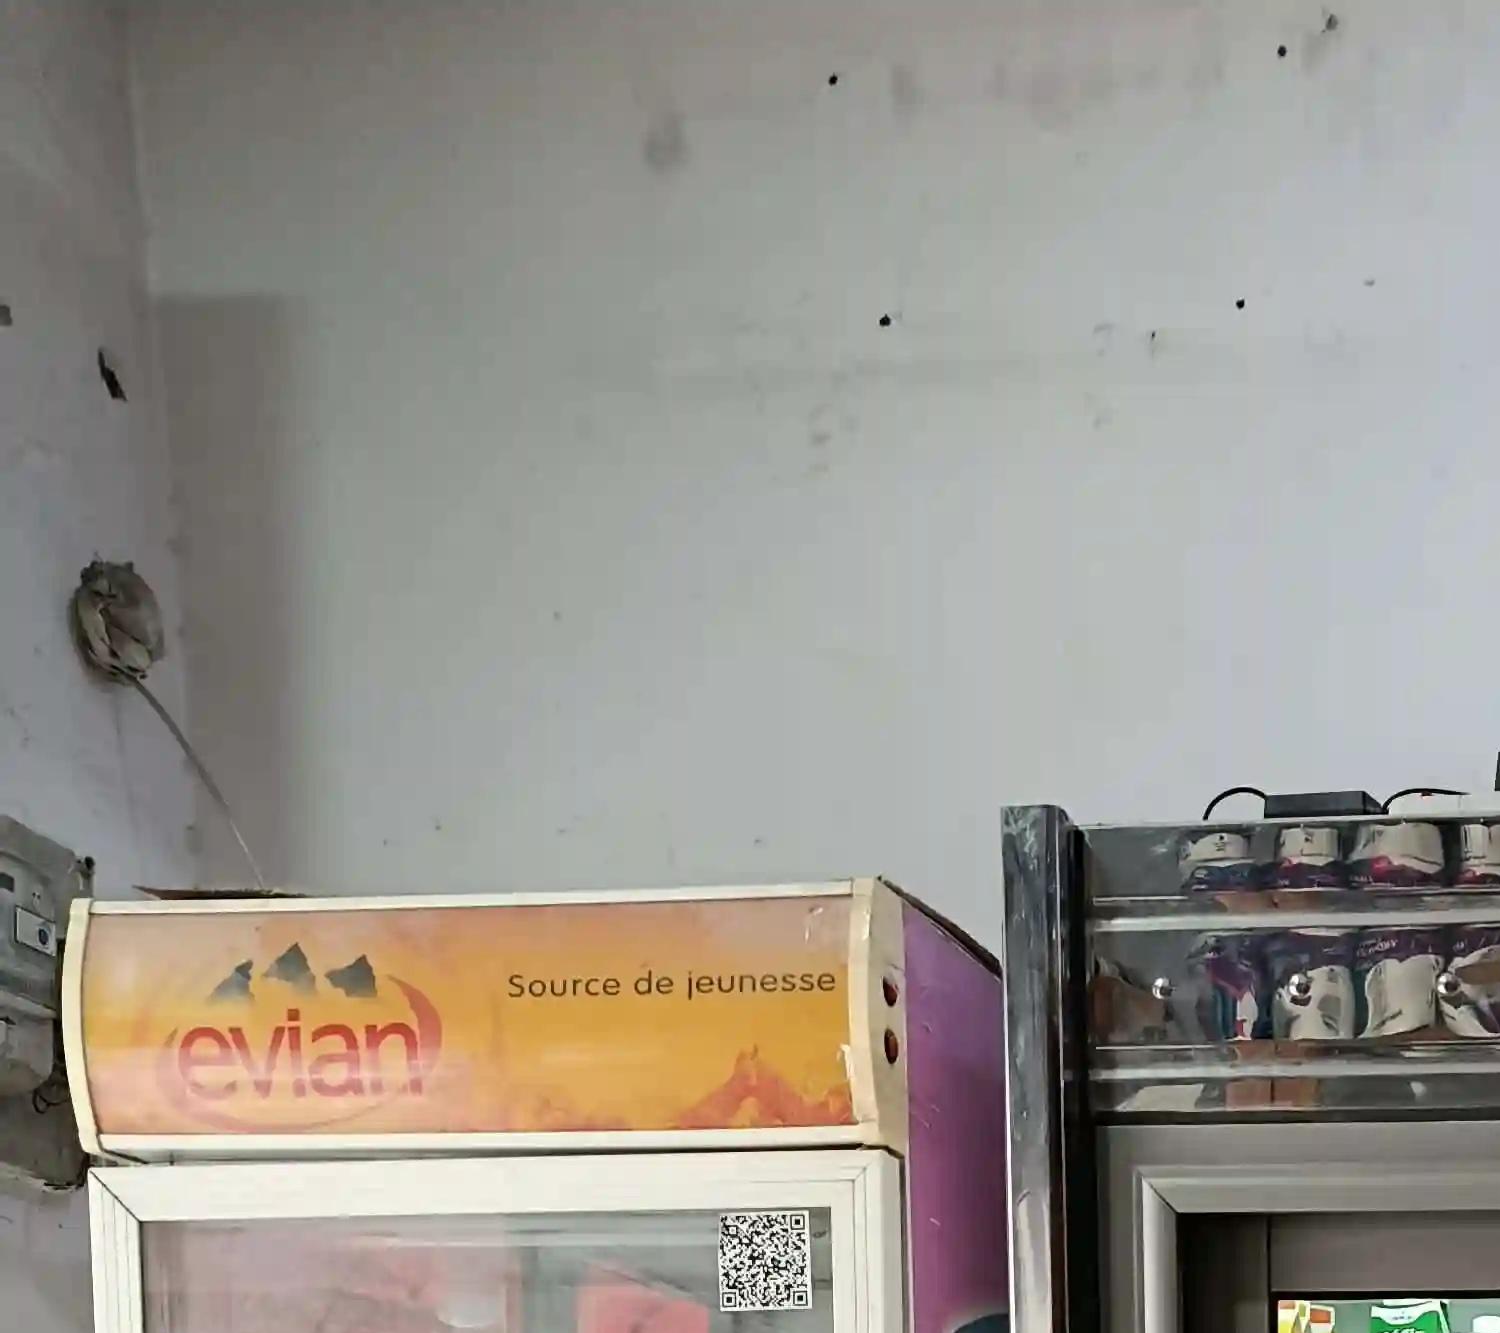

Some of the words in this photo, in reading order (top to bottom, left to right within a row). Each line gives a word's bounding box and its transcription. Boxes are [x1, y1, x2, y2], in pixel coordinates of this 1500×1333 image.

[507, 972, 622, 1000] Source
[632, 968, 675, 998] de
[685, 966, 838, 1003] jeunesse
[178, 1008, 424, 1101] evian
